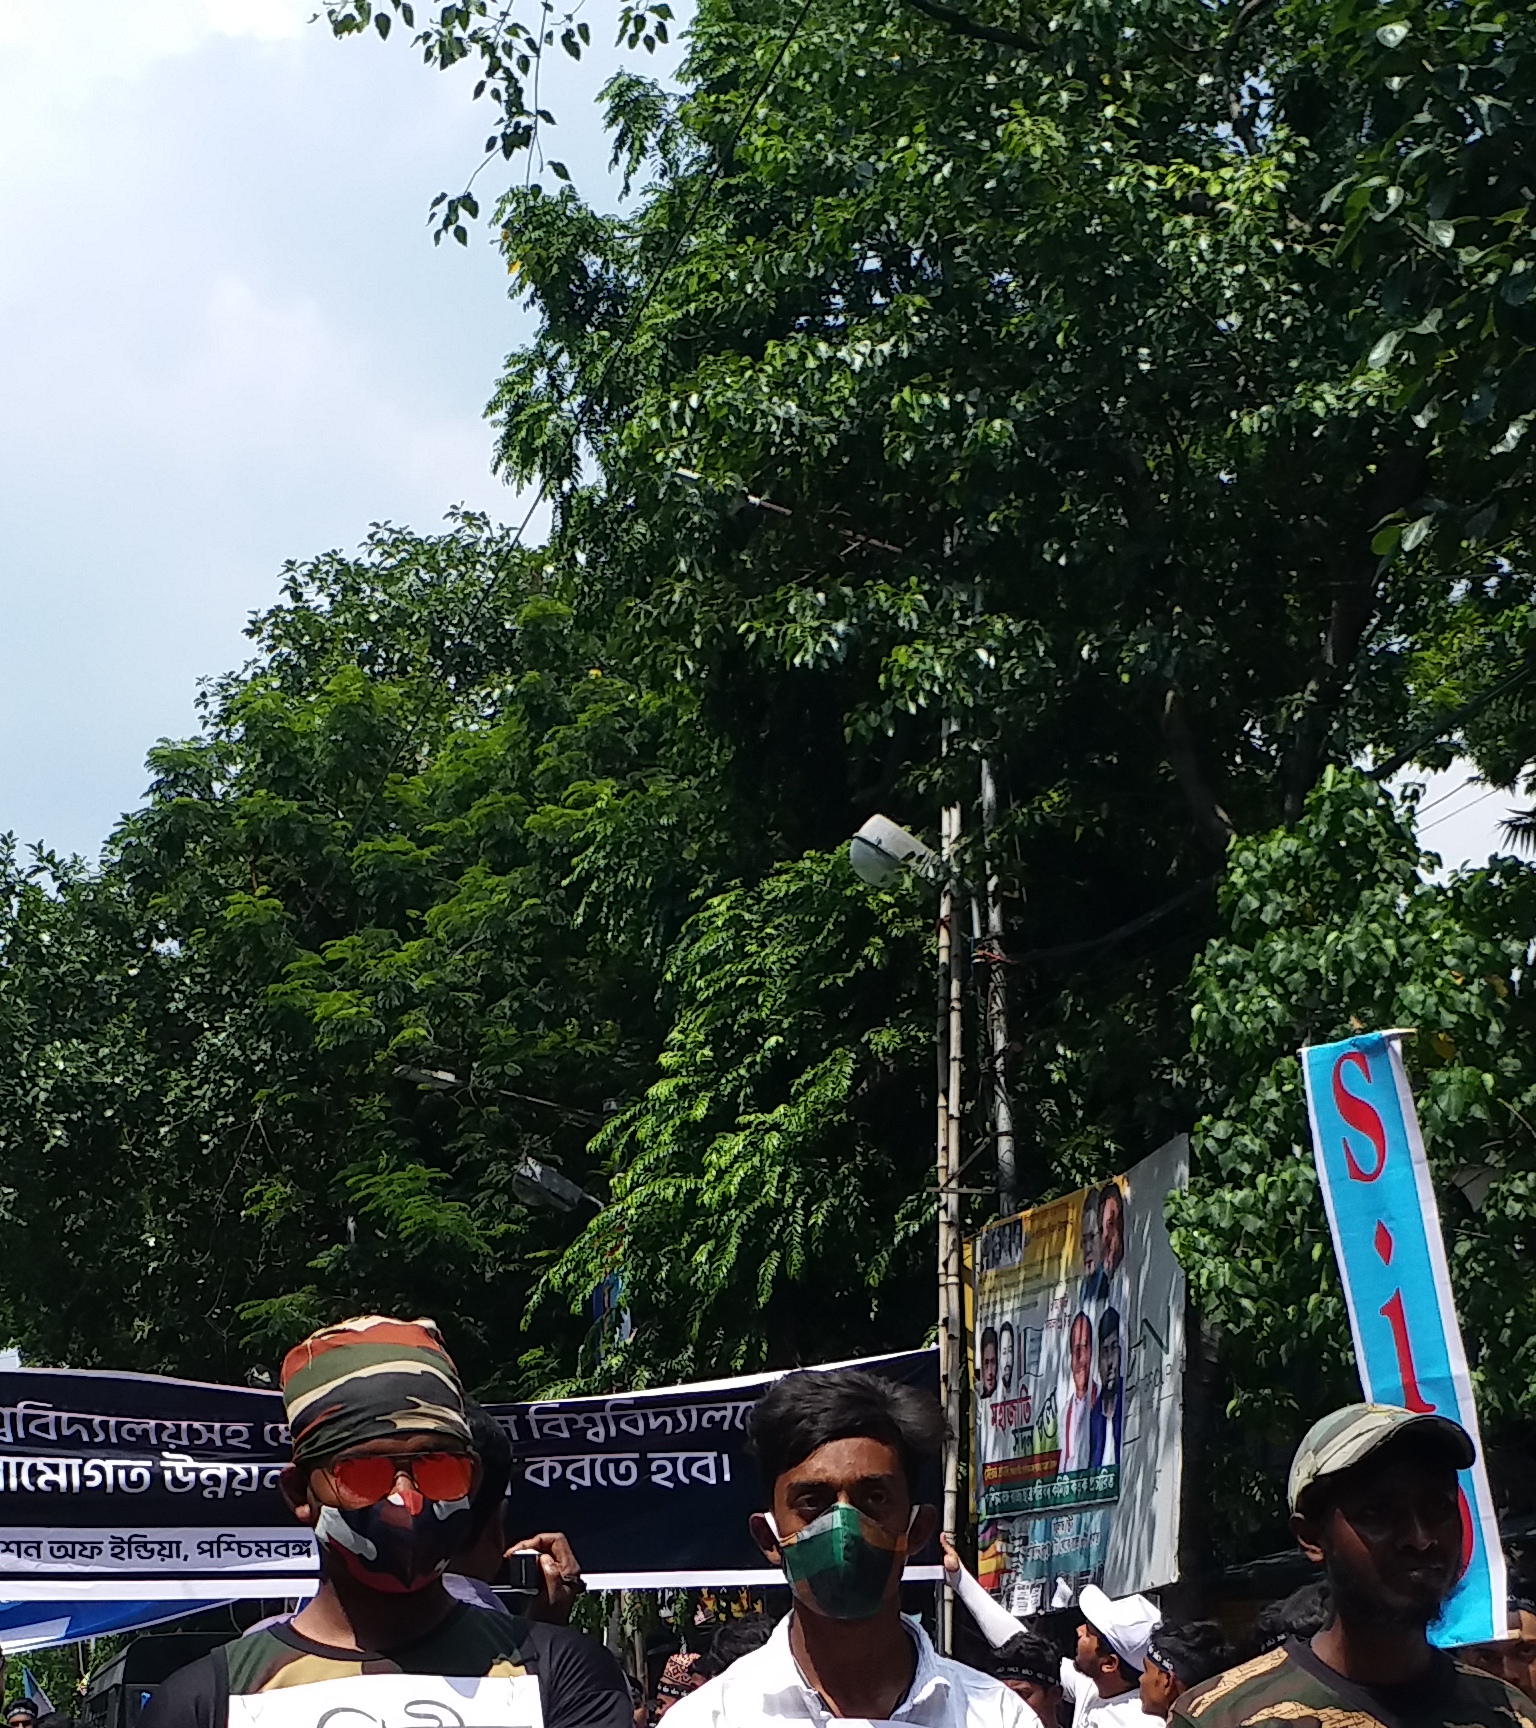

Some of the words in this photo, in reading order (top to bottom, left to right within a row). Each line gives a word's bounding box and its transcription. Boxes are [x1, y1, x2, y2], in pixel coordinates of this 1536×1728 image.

[524, 1453, 639, 1491] করতে
[48, 1538, 103, 1560] অফ
[109, 1535, 189, 1563] ইন্ডিয়া,
[196, 1536, 314, 1562] পশ্চিমবঙ্গ
